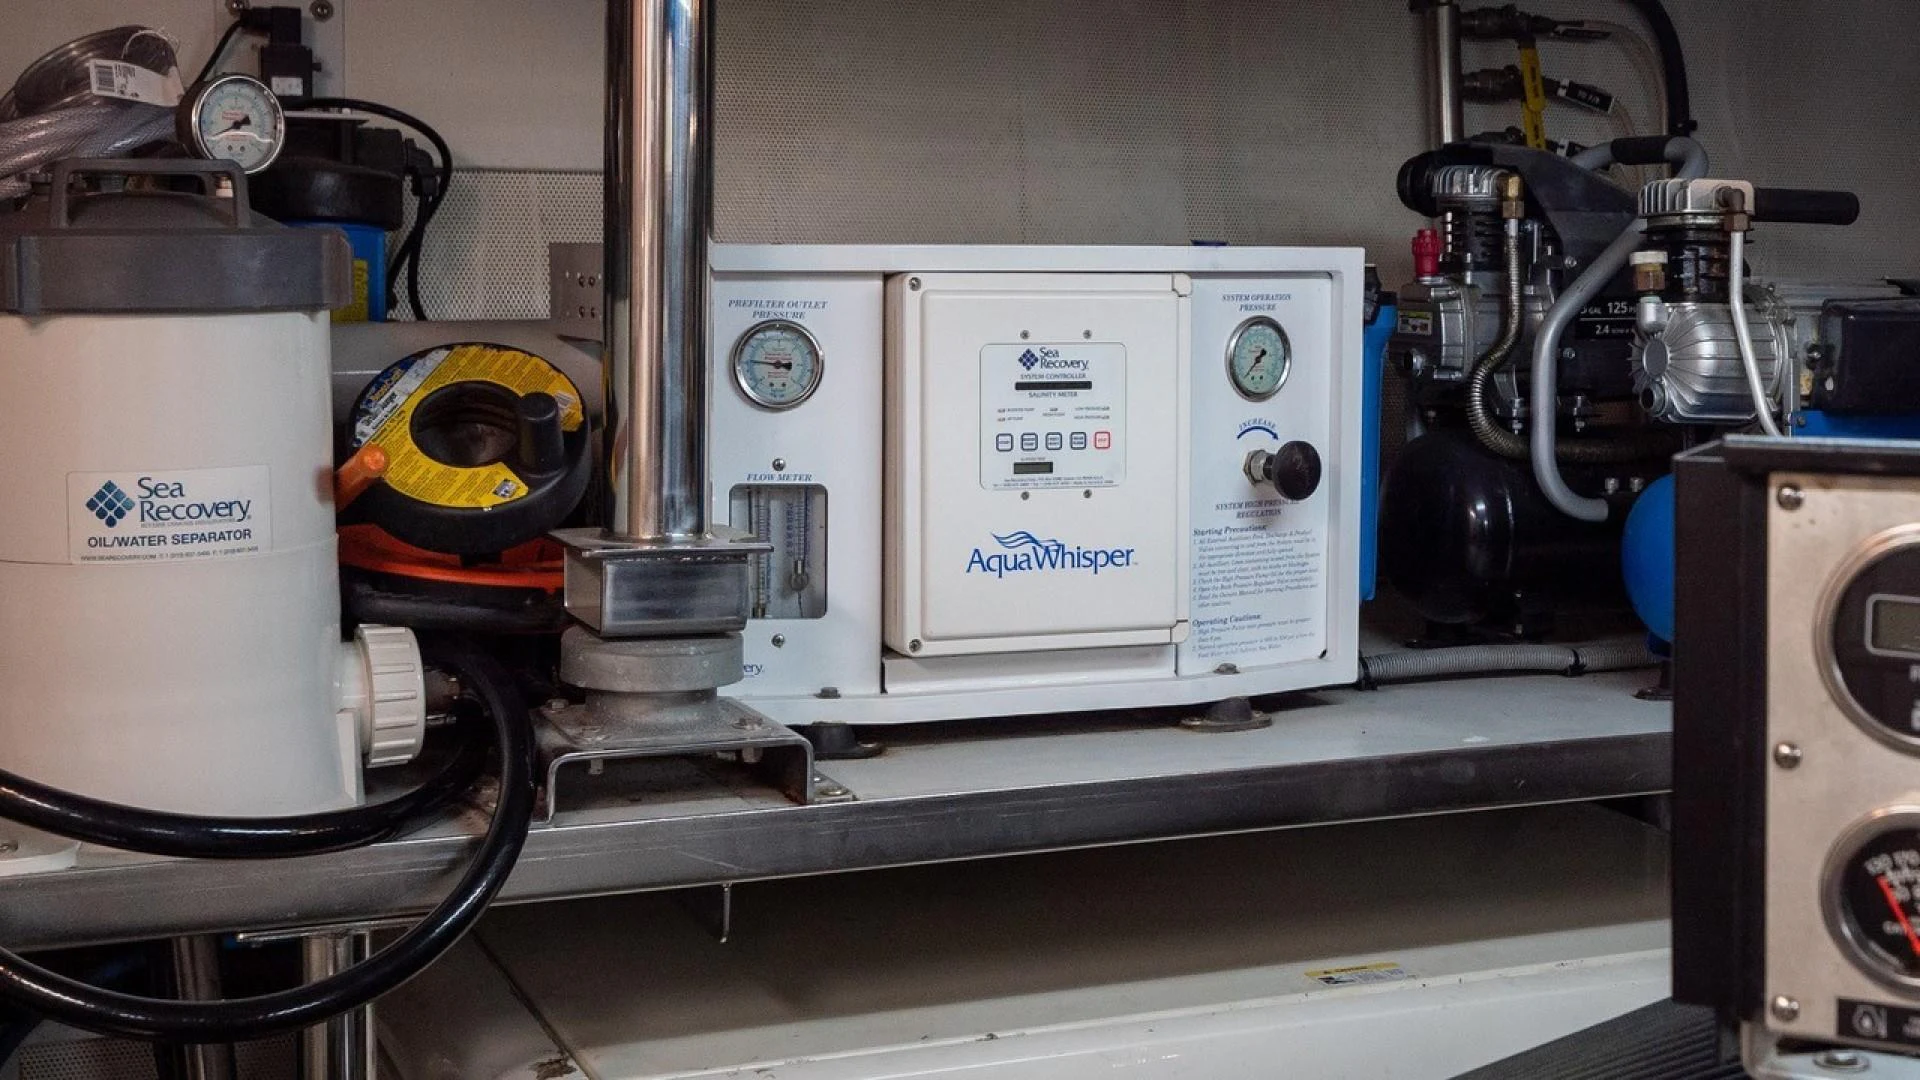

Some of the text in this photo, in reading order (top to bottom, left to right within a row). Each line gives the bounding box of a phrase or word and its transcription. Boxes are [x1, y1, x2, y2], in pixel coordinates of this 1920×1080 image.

[1222, 293, 1291, 302] SYSTEM OPERATION
[728, 299, 828, 309] PREFILTER OUTLET
[1239, 303, 1277, 311] PRESSURE
[1607, 302, 1628, 314] 125
[752, 310, 806, 319] PRESSURE
[1039, 347, 1060, 358] Sea
[1039, 356, 1089, 371] Recovery
[1238, 418, 1277, 431] INCREASE
[746, 473, 813, 482] FLOW METER
[137, 476, 185, 499] Sea
[139, 499, 252, 523] Recovery
[87, 528, 252, 549] OIL/WATER SEPARATOR
[966, 543, 1134, 579] AquaWhisper
